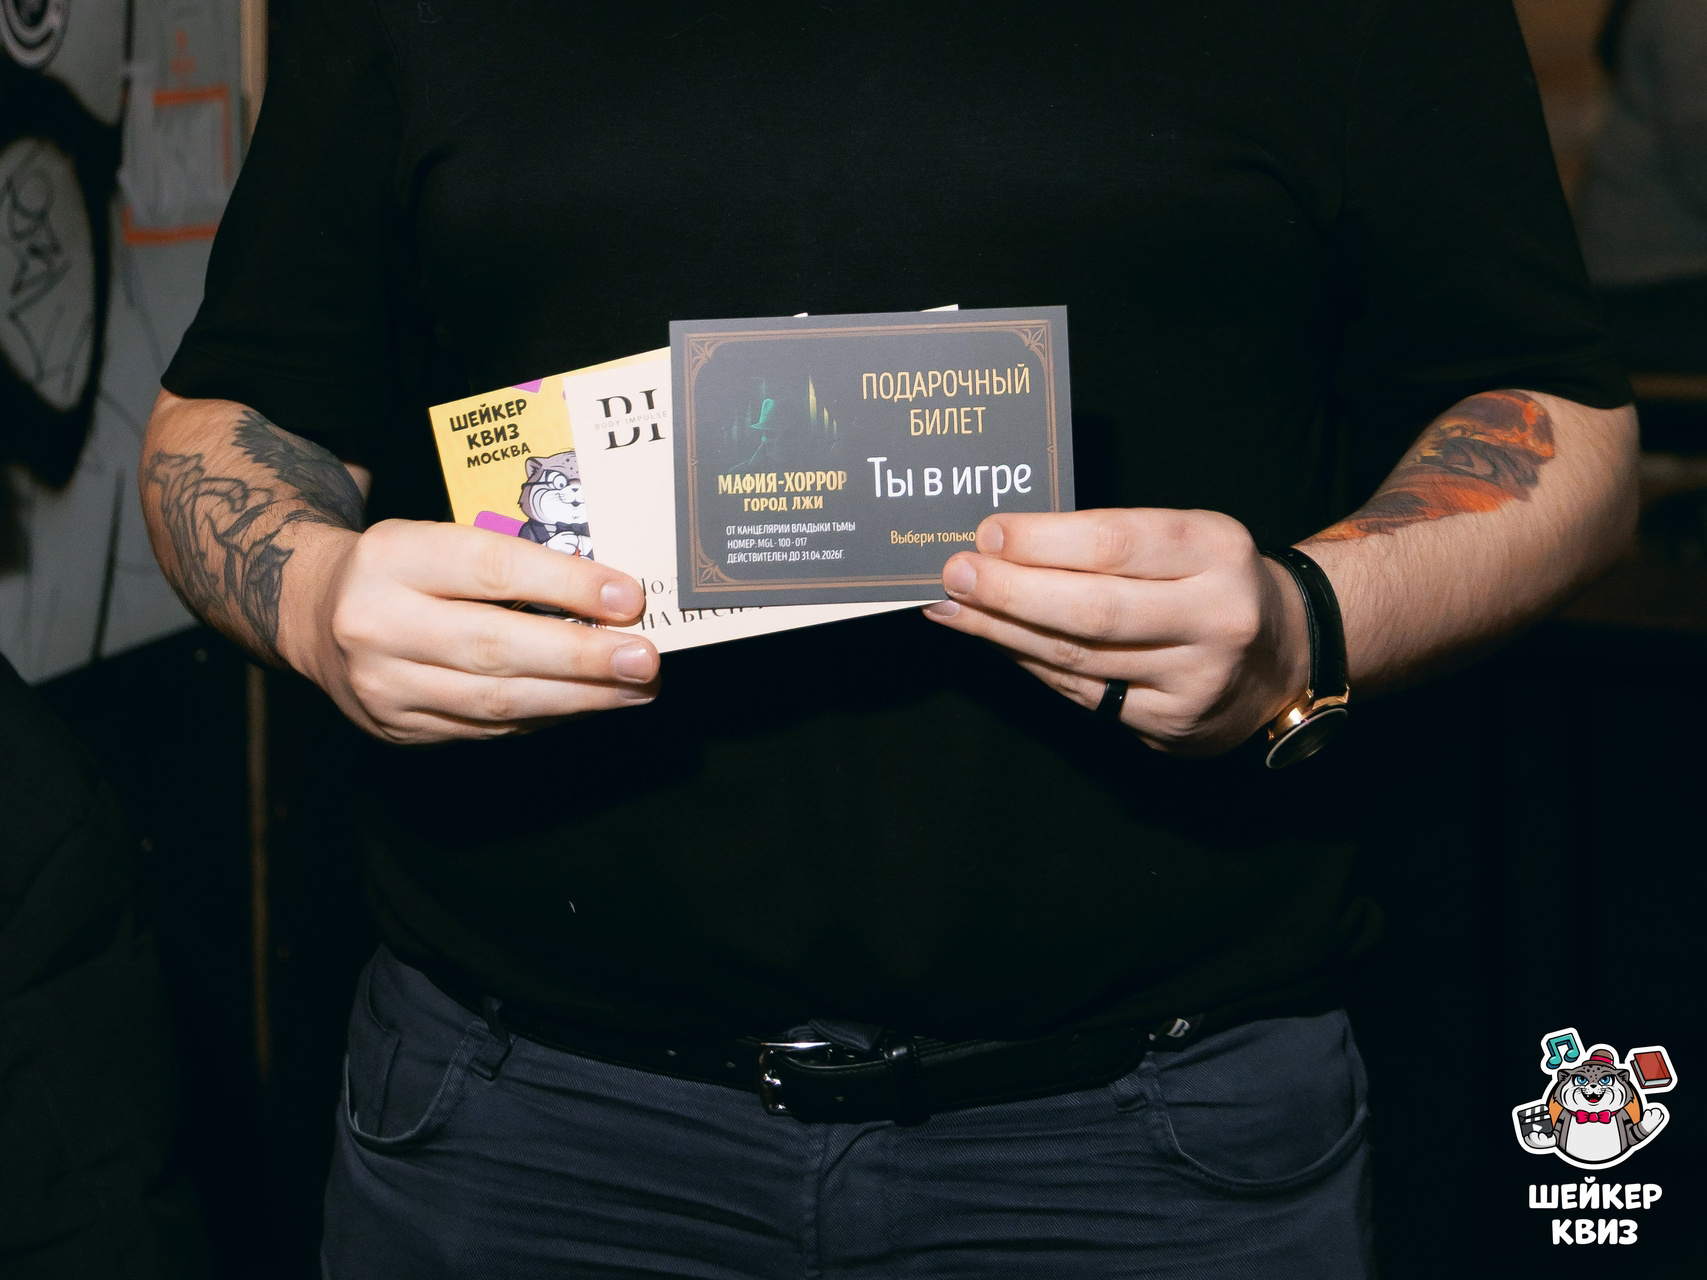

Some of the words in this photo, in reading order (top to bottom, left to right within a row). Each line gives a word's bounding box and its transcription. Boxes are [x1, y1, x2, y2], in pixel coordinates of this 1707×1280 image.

[862, 363, 1031, 403] ПОДАРОЧНЫЙ
[449, 398, 527, 432] ШЕЙКЕР
[594, 420, 621, 431] BODY
[625, 410, 668, 425] IMPULSE
[910, 406, 987, 437] БИЛЕТ
[466, 423, 520, 450] КВИЗ
[466, 441, 531, 468] МОСКВА
[717, 470, 848, 495] МАФИЯ-ХОРРОР
[866, 456, 914, 498] Ты
[923, 466, 944, 496] в
[952, 463, 1032, 508] игре
[743, 496, 788, 512] ГОРОД
[791, 495, 824, 510] ЛЖИ
[726, 525, 736, 536] ОТ
[737, 523, 790, 536] КАНЦЕЛЯРИИ
[791, 522, 831, 534] ВЛАДЫКИ
[832, 521, 856, 532] ТЬМЫ
[890, 530, 935, 547] Выбери
[937, 530, 976, 543] только
[727, 538, 757, 550] НОМЕР:
[727, 551, 787, 564] ДЕЙСТВИТЕЛЕН
[789, 550, 801, 562] ДО
[640, 610, 672, 631] НА
